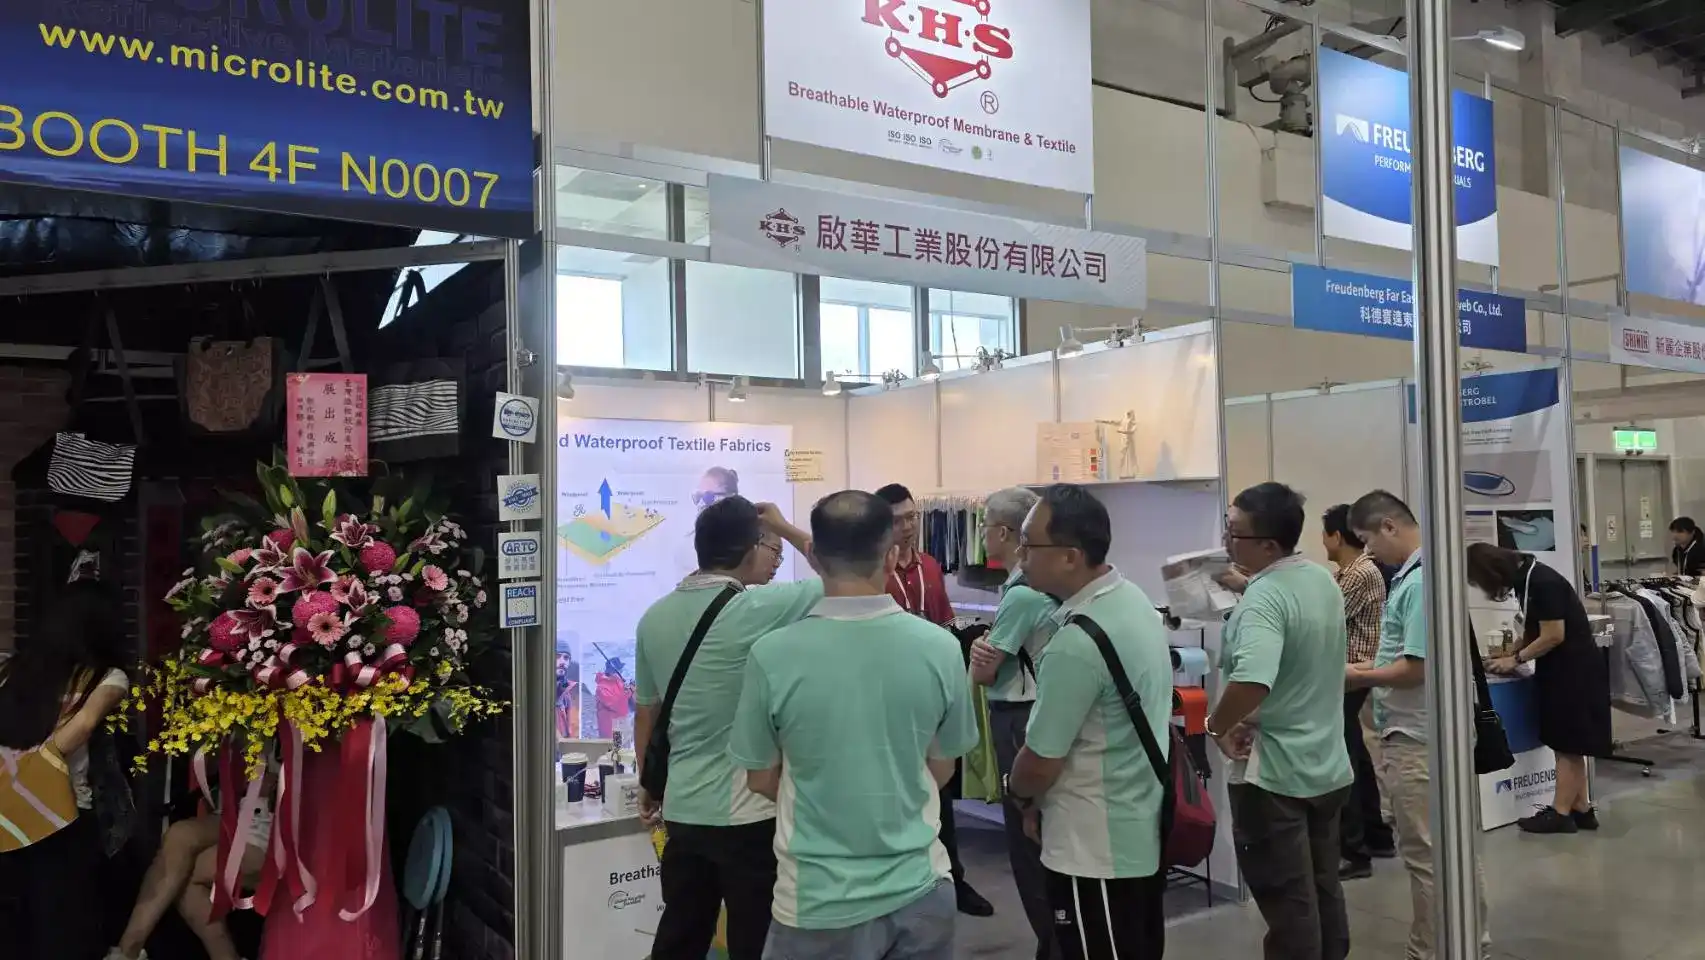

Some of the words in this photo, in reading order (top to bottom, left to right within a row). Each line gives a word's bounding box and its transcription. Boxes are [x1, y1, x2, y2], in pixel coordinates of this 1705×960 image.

[38, 22, 505, 120] www.microlite.com.tw
[788, 81, 869, 112] Breathable
[873, 99, 949, 130] Waterproof
[953, 118, 1020, 144] Membrane
[1023, 132, 1033, 146] &
[1036, 134, 1076, 154] Textile
[888, 130, 901, 139] ISO
[903, 133, 916, 143] ISO
[919, 135, 932, 145] ISO
[1374, 153, 1412, 174] PERFORM
[250, 141, 319, 183] 4F
[342, 151, 500, 208] N0007
[1325, 279, 1385, 304] Freudenberg
[1386, 288, 1400, 302] Far
[1401, 290, 1415, 304] Eas
[1488, 303, 1503, 317] Ltd.
[574, 433, 665, 453] Waterproof
[667, 436, 716, 452] Textile
[719, 438, 772, 452] Fabrics
[506, 541, 535, 553] ARTC
[507, 587, 535, 598] REACH
[1513, 768, 1556, 789] FREUDENB
[609, 864, 661, 886] Breatha
